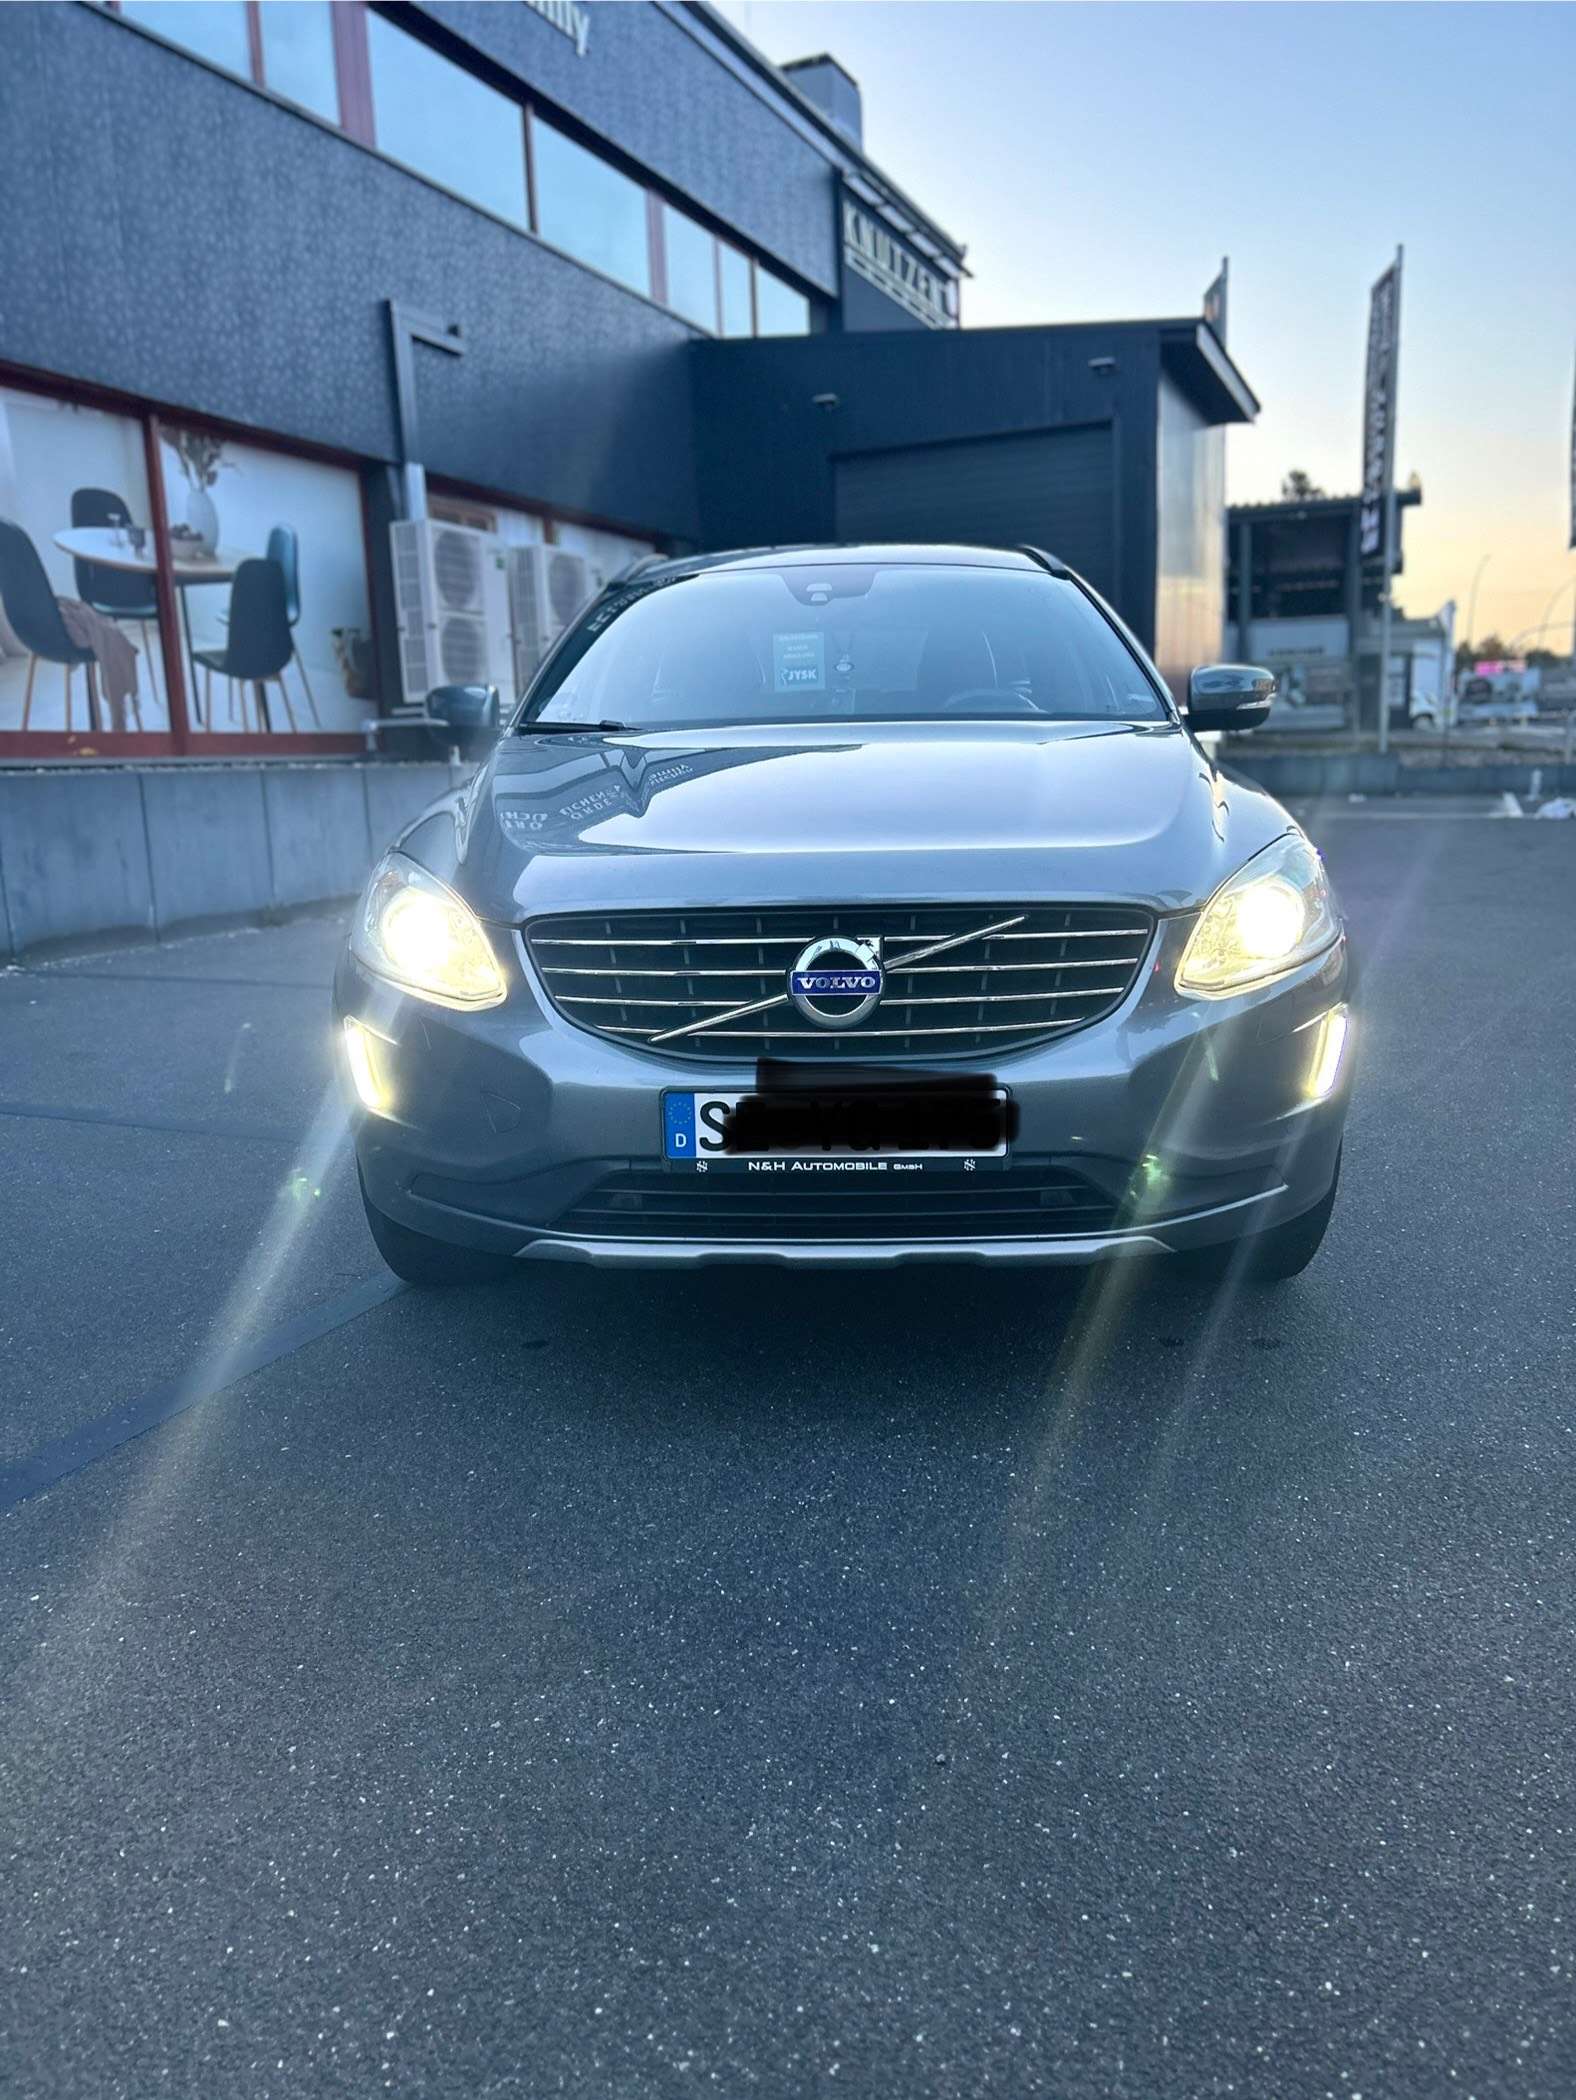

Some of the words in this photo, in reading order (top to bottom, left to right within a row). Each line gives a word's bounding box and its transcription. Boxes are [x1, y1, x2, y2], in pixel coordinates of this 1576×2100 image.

[797, 976, 876, 989] VOLVO
[675, 1133, 687, 1148] D
[748, 1161, 786, 1171] N&H
